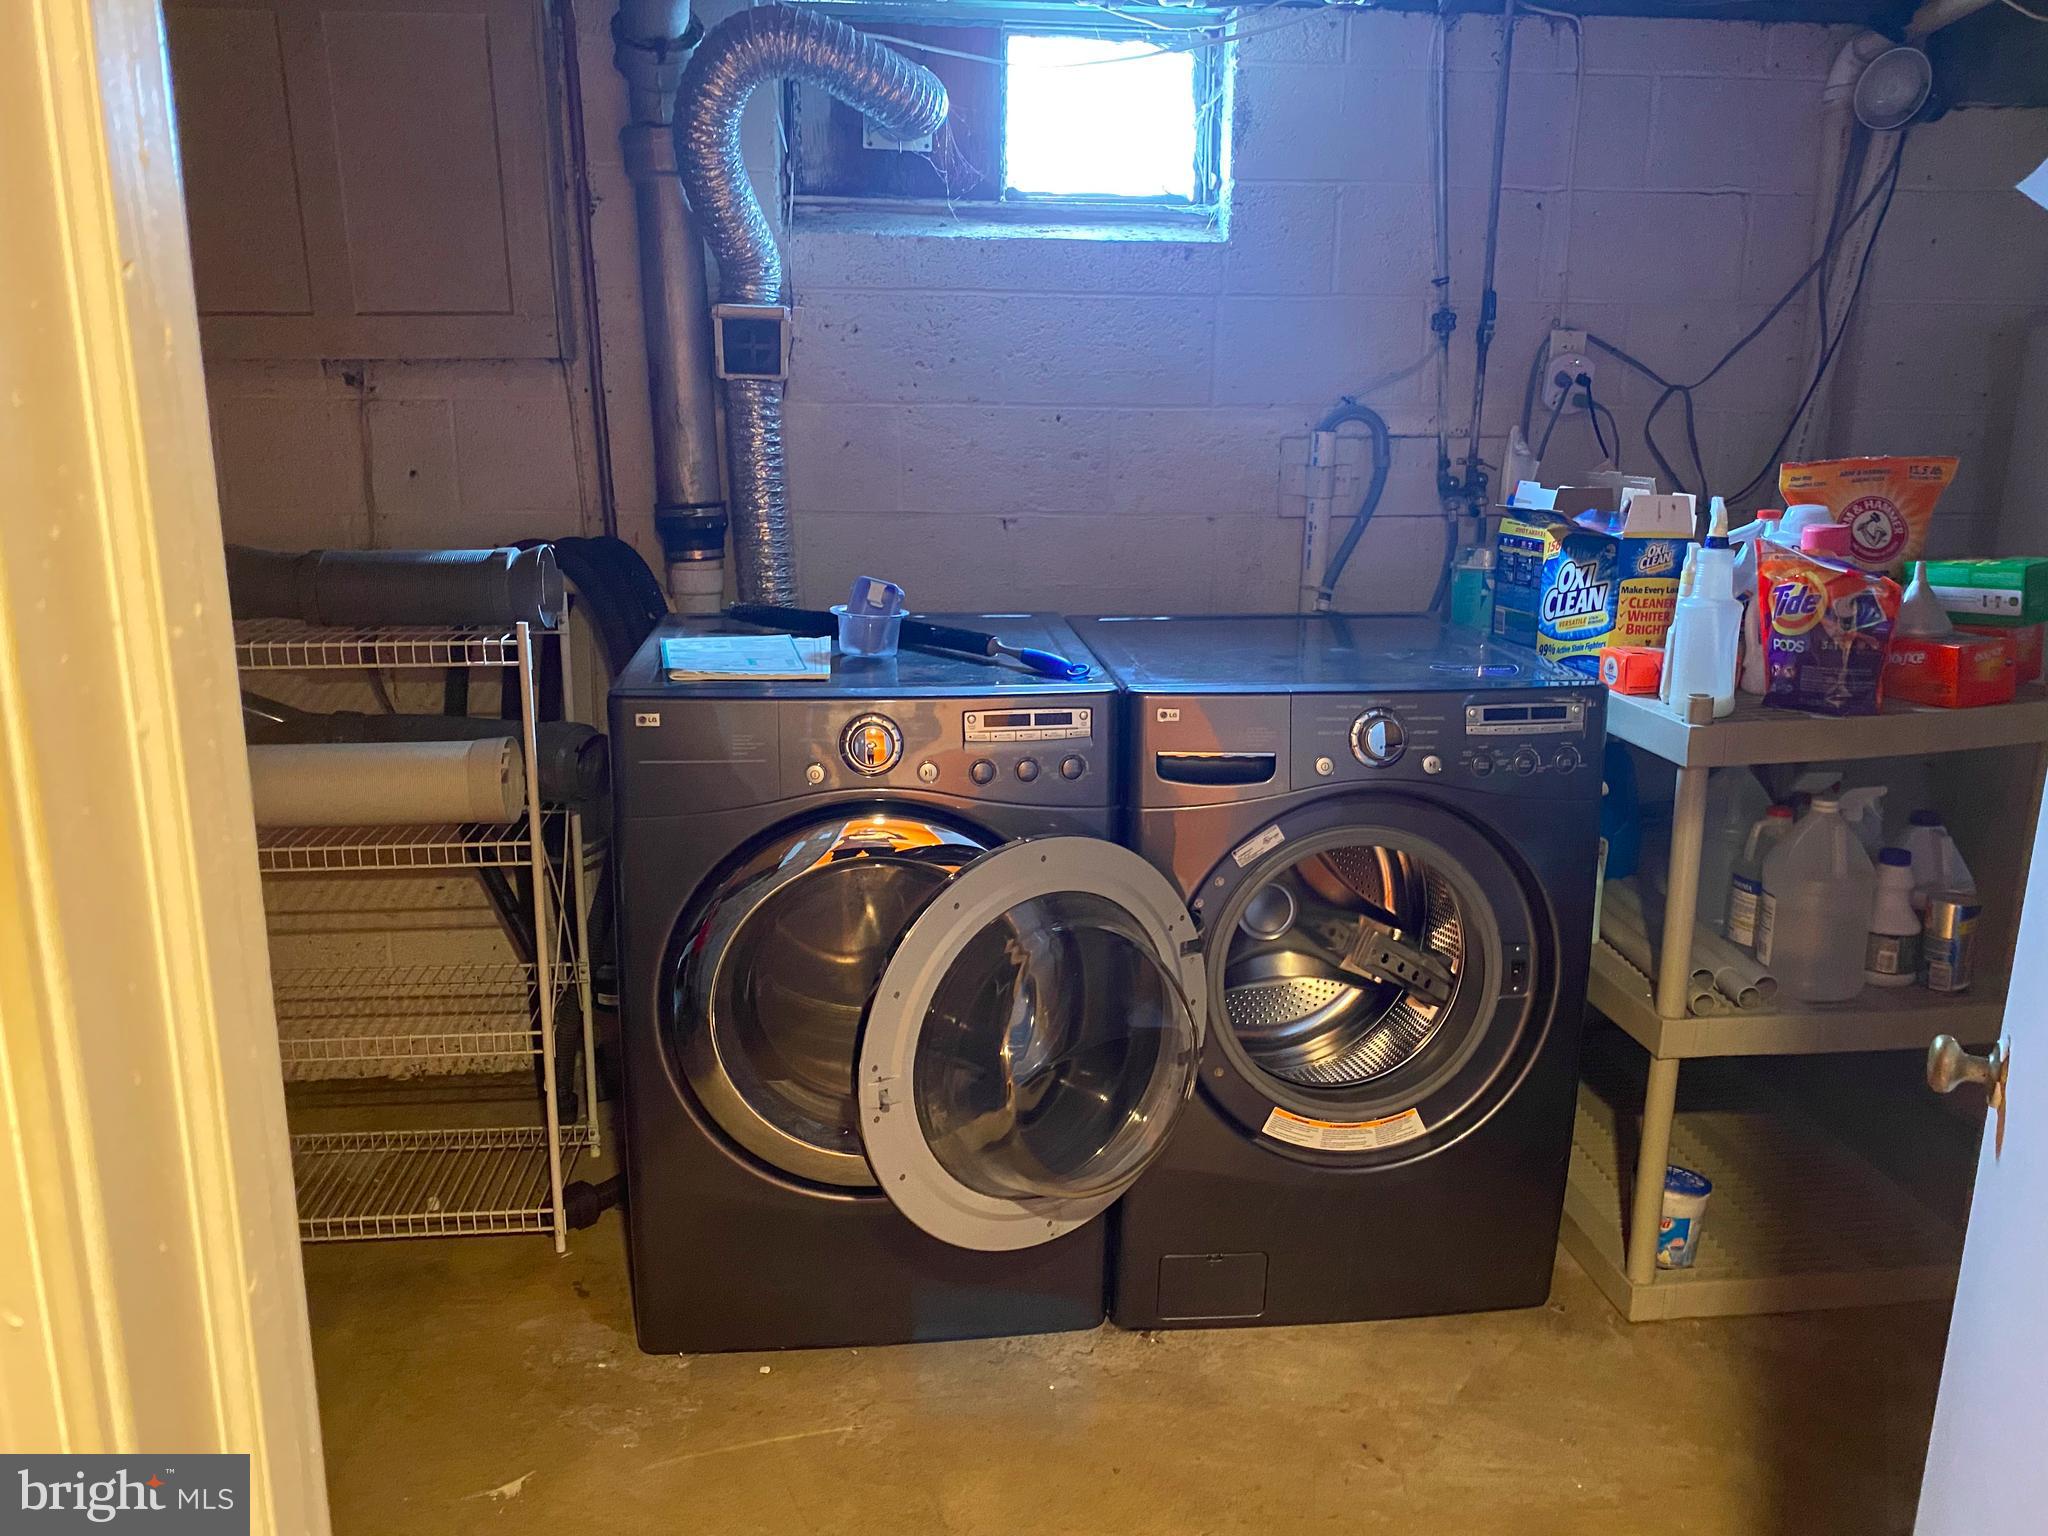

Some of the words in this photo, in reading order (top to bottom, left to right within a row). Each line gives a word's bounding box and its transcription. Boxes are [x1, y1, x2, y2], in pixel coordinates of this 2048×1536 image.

[1863, 499, 1904, 534] HAMMER
[1647, 544, 1667, 559] OXI
[1639, 551, 1672, 570] CLEAN
[1557, 561, 1596, 594] OXI
[1621, 586, 1643, 594] Make
[1644, 586, 1665, 596] Every
[1544, 583, 1608, 621] CLEAN
[1628, 596, 1677, 609] CLEANER
[1772, 584, 1822, 621] Tide
[1627, 610, 1670, 622] WHITER
[1625, 623, 1668, 635] BRIGHT
[1538, 643, 1556, 656] 99%
[1773, 638, 1805, 653] PODS
